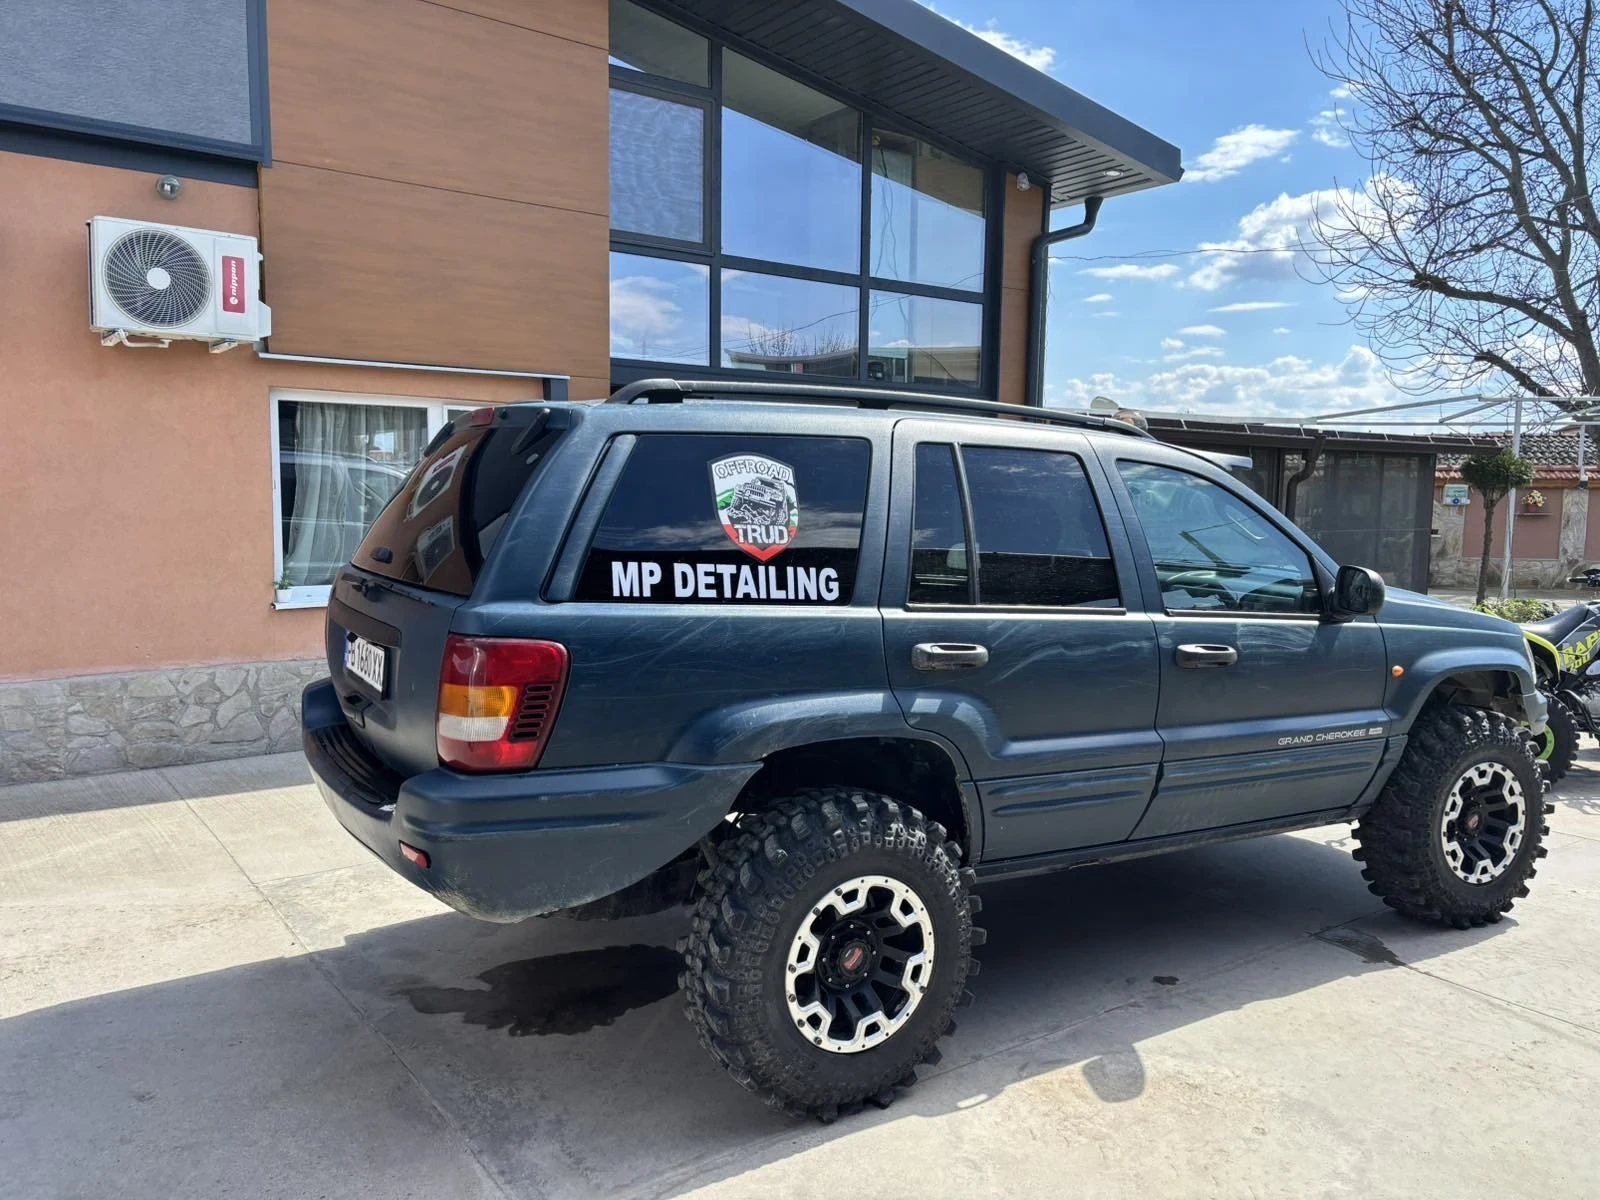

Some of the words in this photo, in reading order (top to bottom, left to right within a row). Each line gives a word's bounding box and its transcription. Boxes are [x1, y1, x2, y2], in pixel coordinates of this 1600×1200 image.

[230, 260, 238, 296] nippon
[714, 459, 791, 482] OFFROAD
[734, 524, 790, 545] TRUD
[611, 561, 663, 598] MP
[673, 563, 840, 601] DETAILING
[1563, 629, 1600, 666] RAP
[1277, 734, 1314, 746] GRAND
[1315, 728, 1367, 742] CHEROKEE
